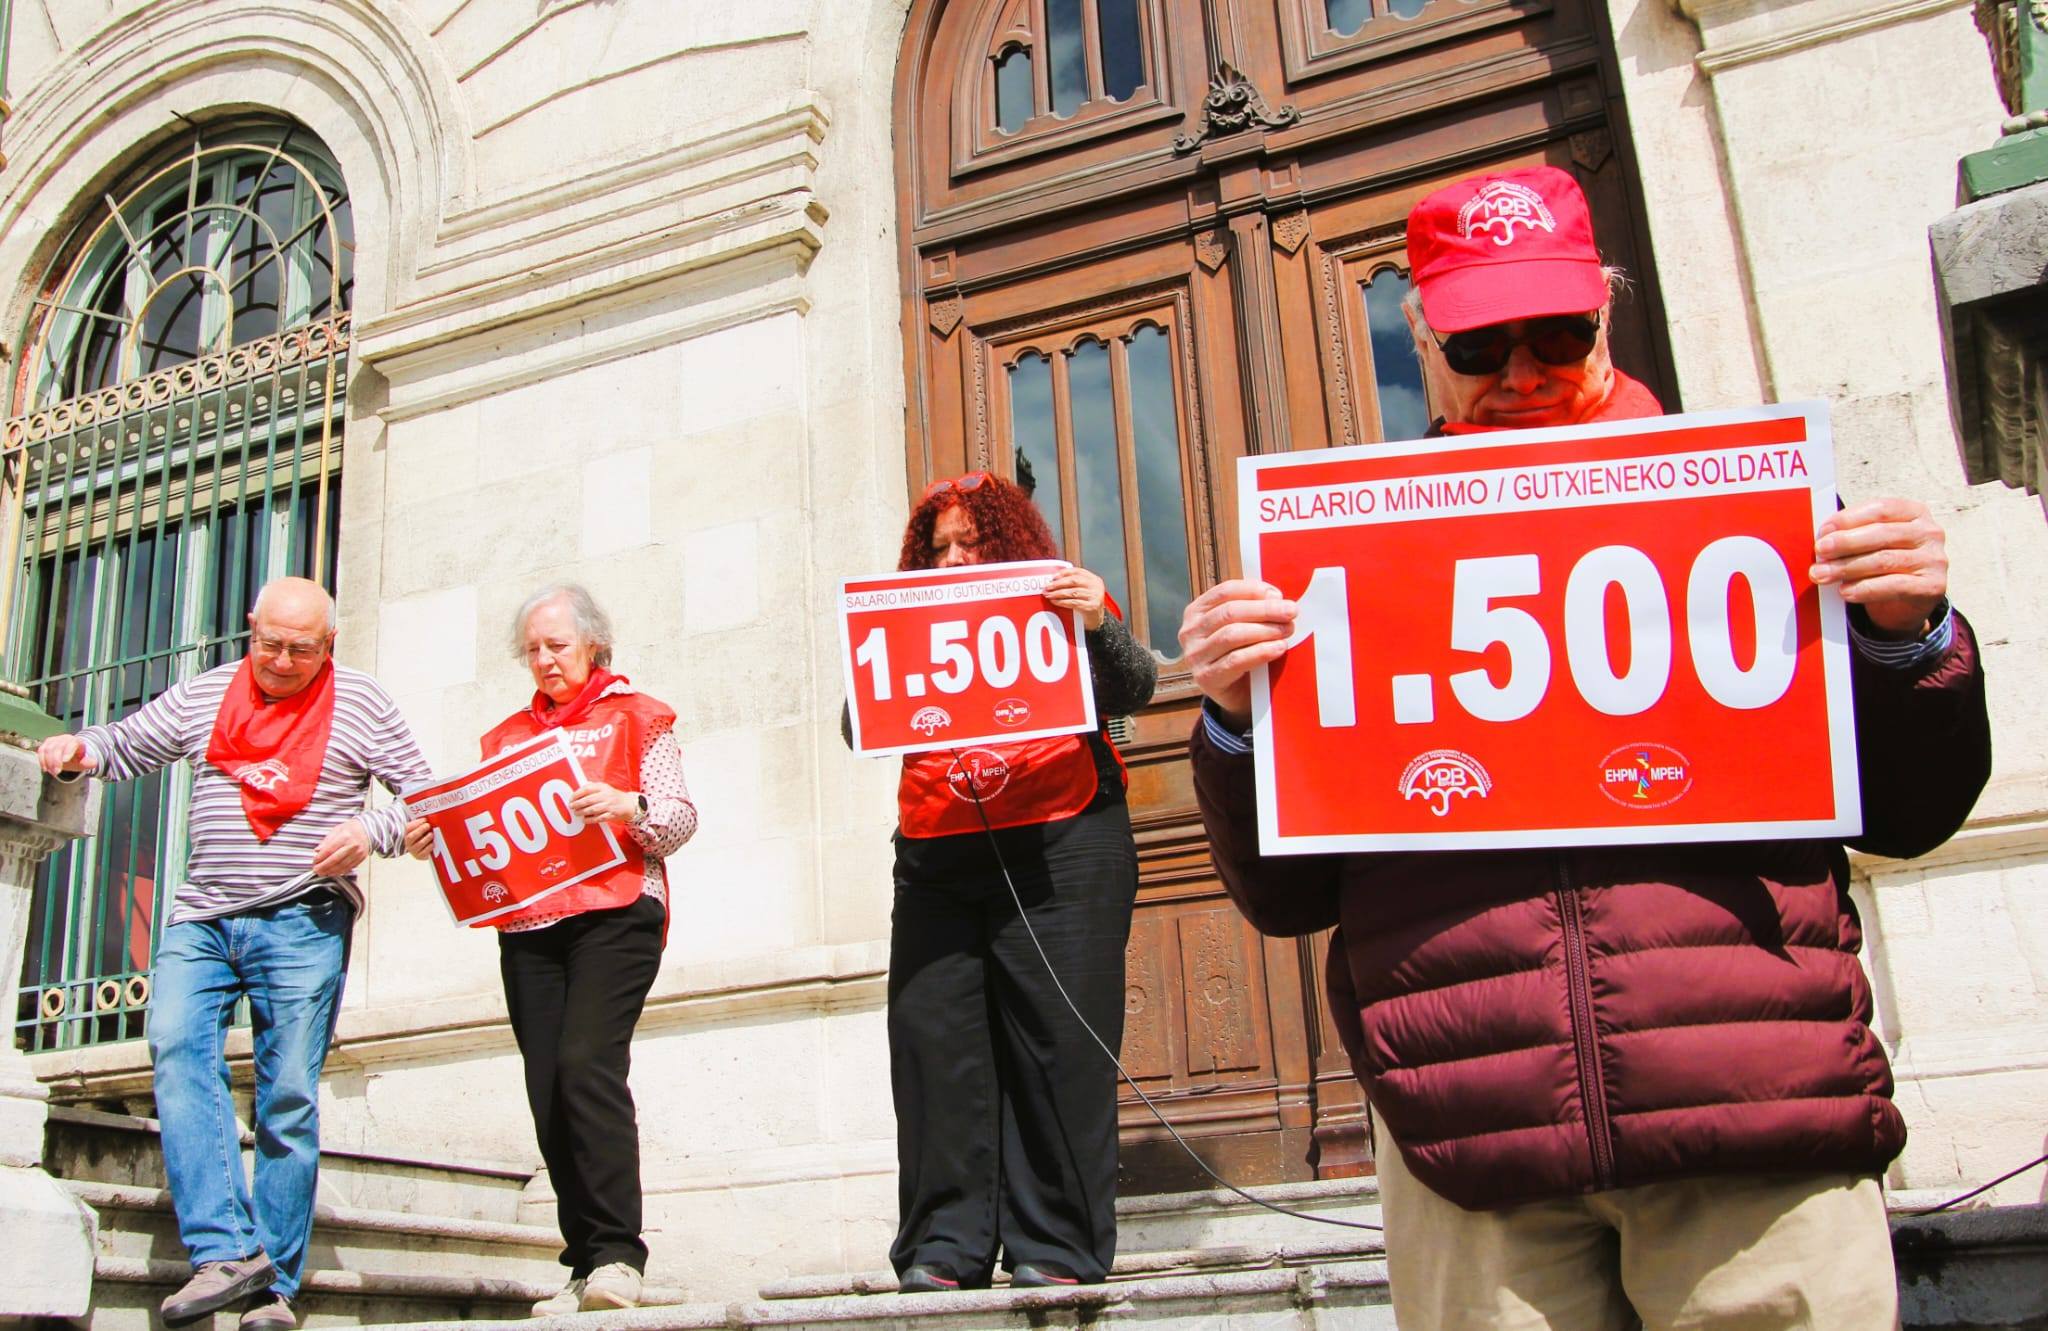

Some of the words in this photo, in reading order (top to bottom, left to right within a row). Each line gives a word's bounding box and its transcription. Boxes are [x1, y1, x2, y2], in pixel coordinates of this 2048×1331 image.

[1259, 489, 1376, 523] SALARIO
[1385, 479, 1488, 512] MÍNIMO
[1496, 477, 1505, 502] /
[1513, 461, 1676, 500] GUTXIENEKO
[1683, 449, 1808, 486] SOLDATA
[846, 592, 897, 609] SALARIO
[900, 588, 944, 604] MÍNIMO
[953, 580, 1021, 599] GUTXIENEKO
[856, 611, 1070, 701] 1.500
[1287, 535, 1798, 729] 1.500
[982, 766, 1006, 778] MPEH
[1605, 767, 1638, 783] EHPM
[1650, 766, 1684, 781] MPEH
[432, 779, 587, 884] 1.500
